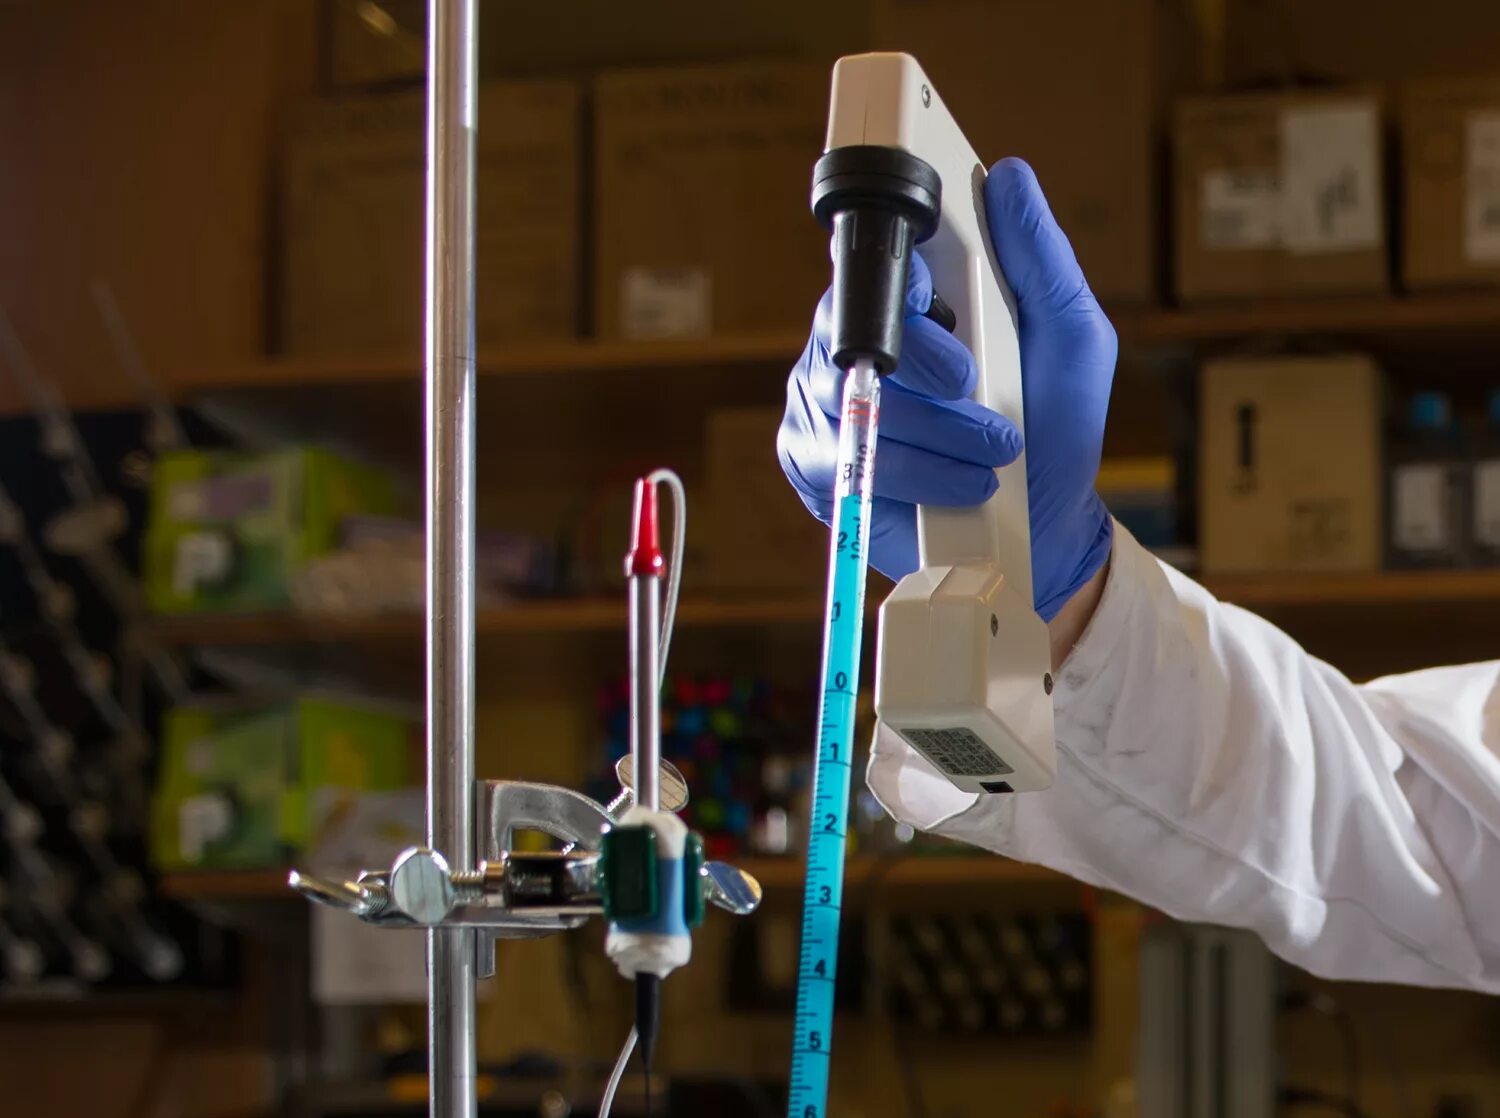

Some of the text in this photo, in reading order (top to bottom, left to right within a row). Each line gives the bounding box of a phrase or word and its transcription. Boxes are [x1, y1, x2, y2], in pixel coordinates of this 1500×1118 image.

[835, 671, 847, 689] 0
[830, 743, 840, 760] 1
[824, 813, 837, 831] 2
[819, 885, 832, 904] 3
[813, 958, 827, 977] 4
[808, 1030, 822, 1050] 5
